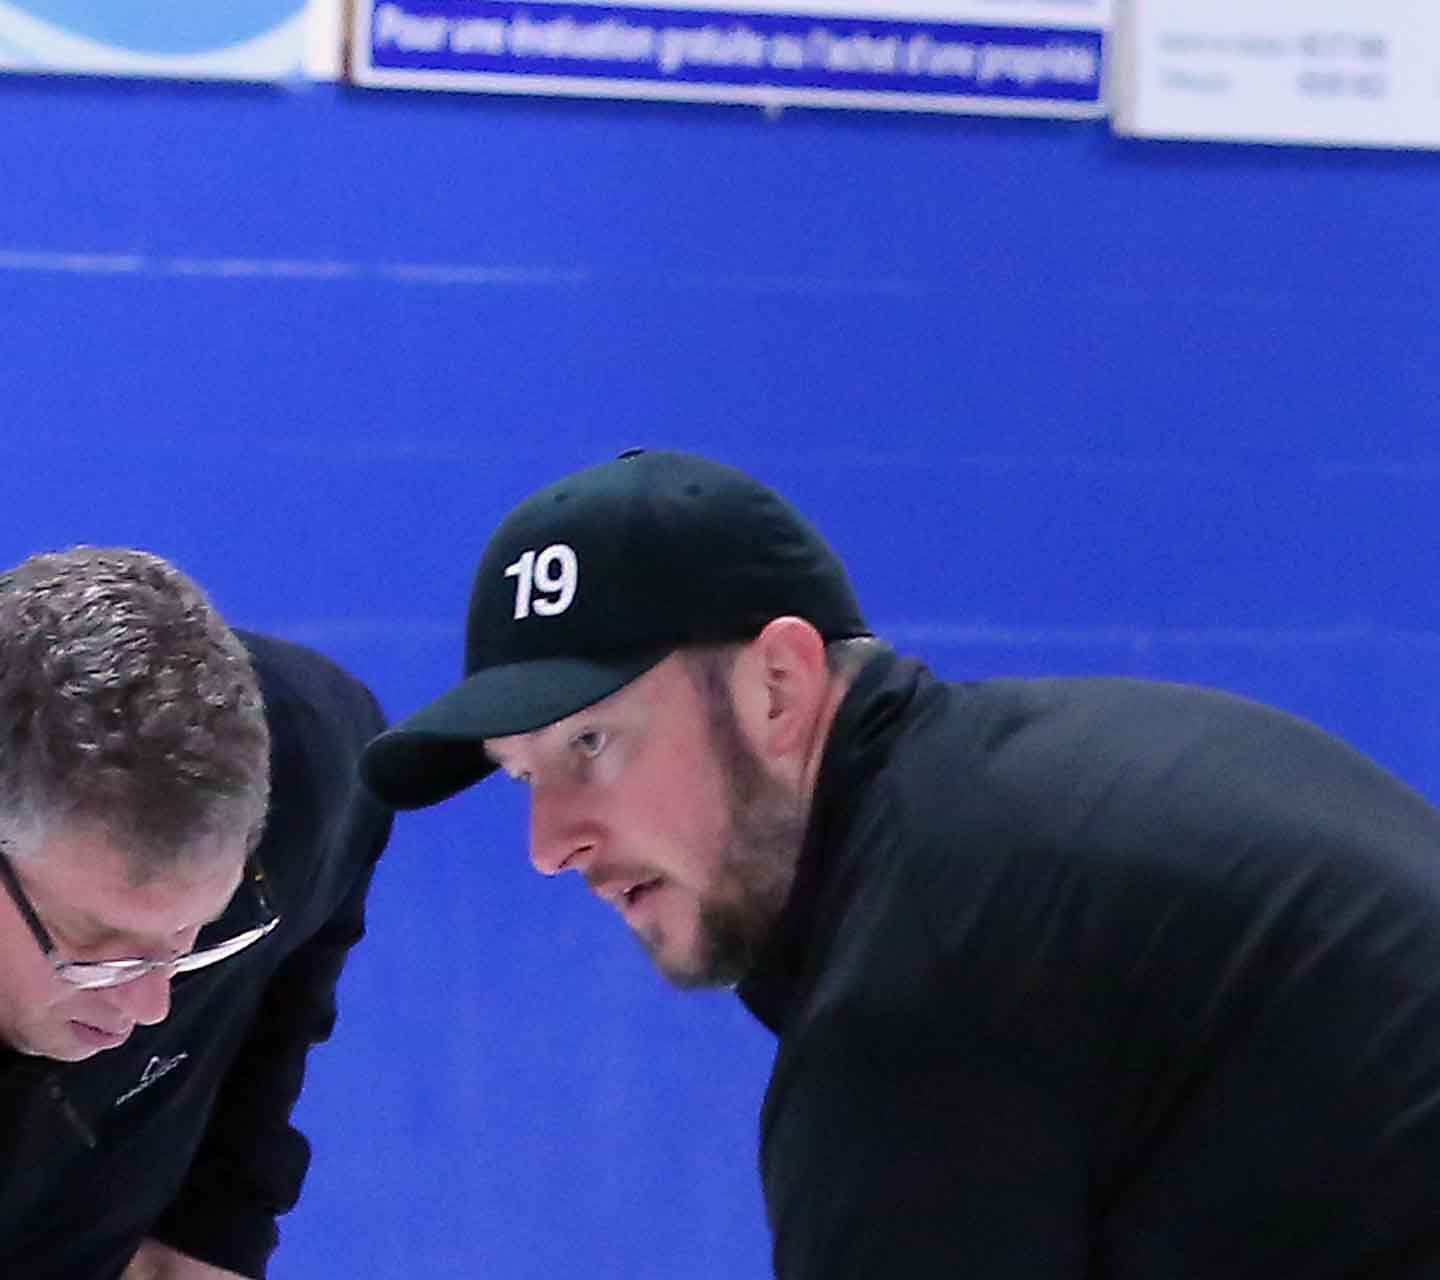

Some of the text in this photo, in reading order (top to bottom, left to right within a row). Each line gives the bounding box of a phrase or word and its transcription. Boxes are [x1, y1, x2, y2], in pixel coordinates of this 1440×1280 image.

[377, 3, 447, 53] Pour
[451, 18, 505, 53] une
[510, 8, 654, 62] évaluation
[658, 24, 764, 73] gratuite
[504, 543, 579, 620] 19
